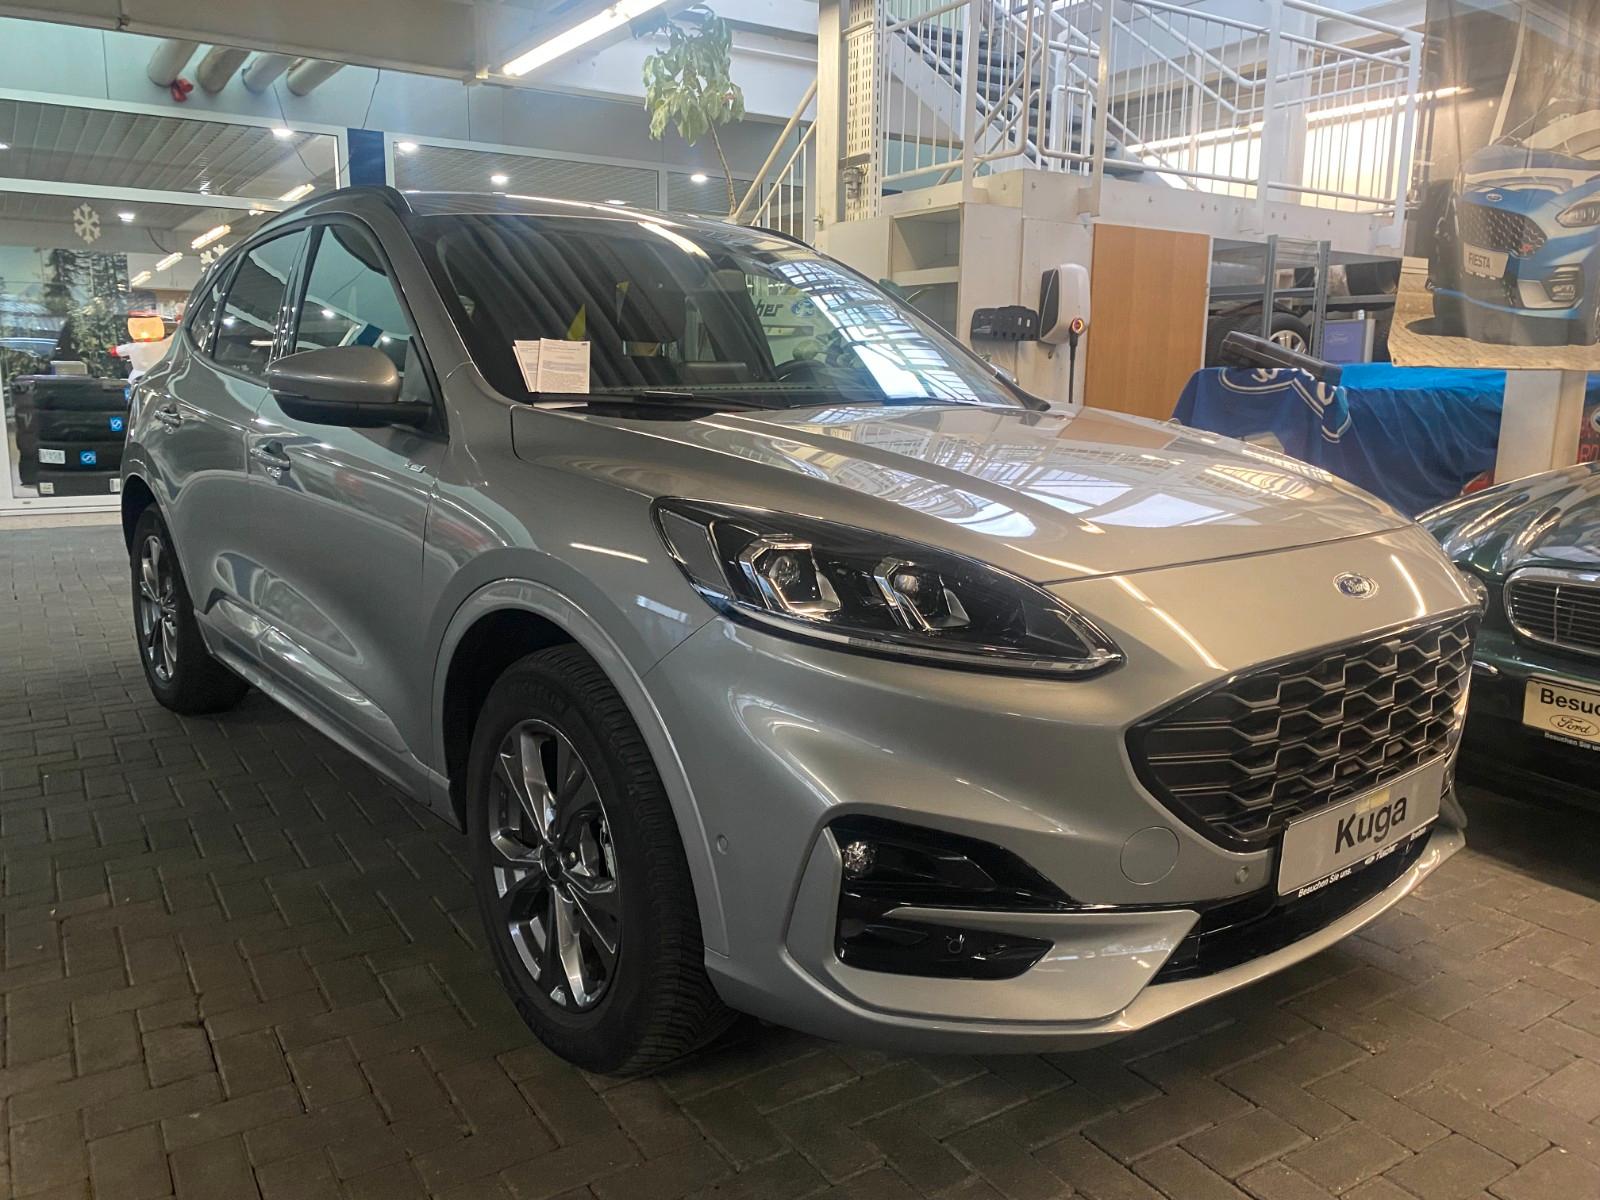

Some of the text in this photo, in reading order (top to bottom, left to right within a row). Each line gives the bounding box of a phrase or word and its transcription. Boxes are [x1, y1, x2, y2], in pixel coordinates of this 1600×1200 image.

[1468, 252, 1491, 270] FIESTA
[1556, 716, 1592, 734] Ford
[1335, 796, 1407, 854] Kuga
[1298, 878, 1329, 898] Besuchen
[1329, 873, 1339, 884] Sie
